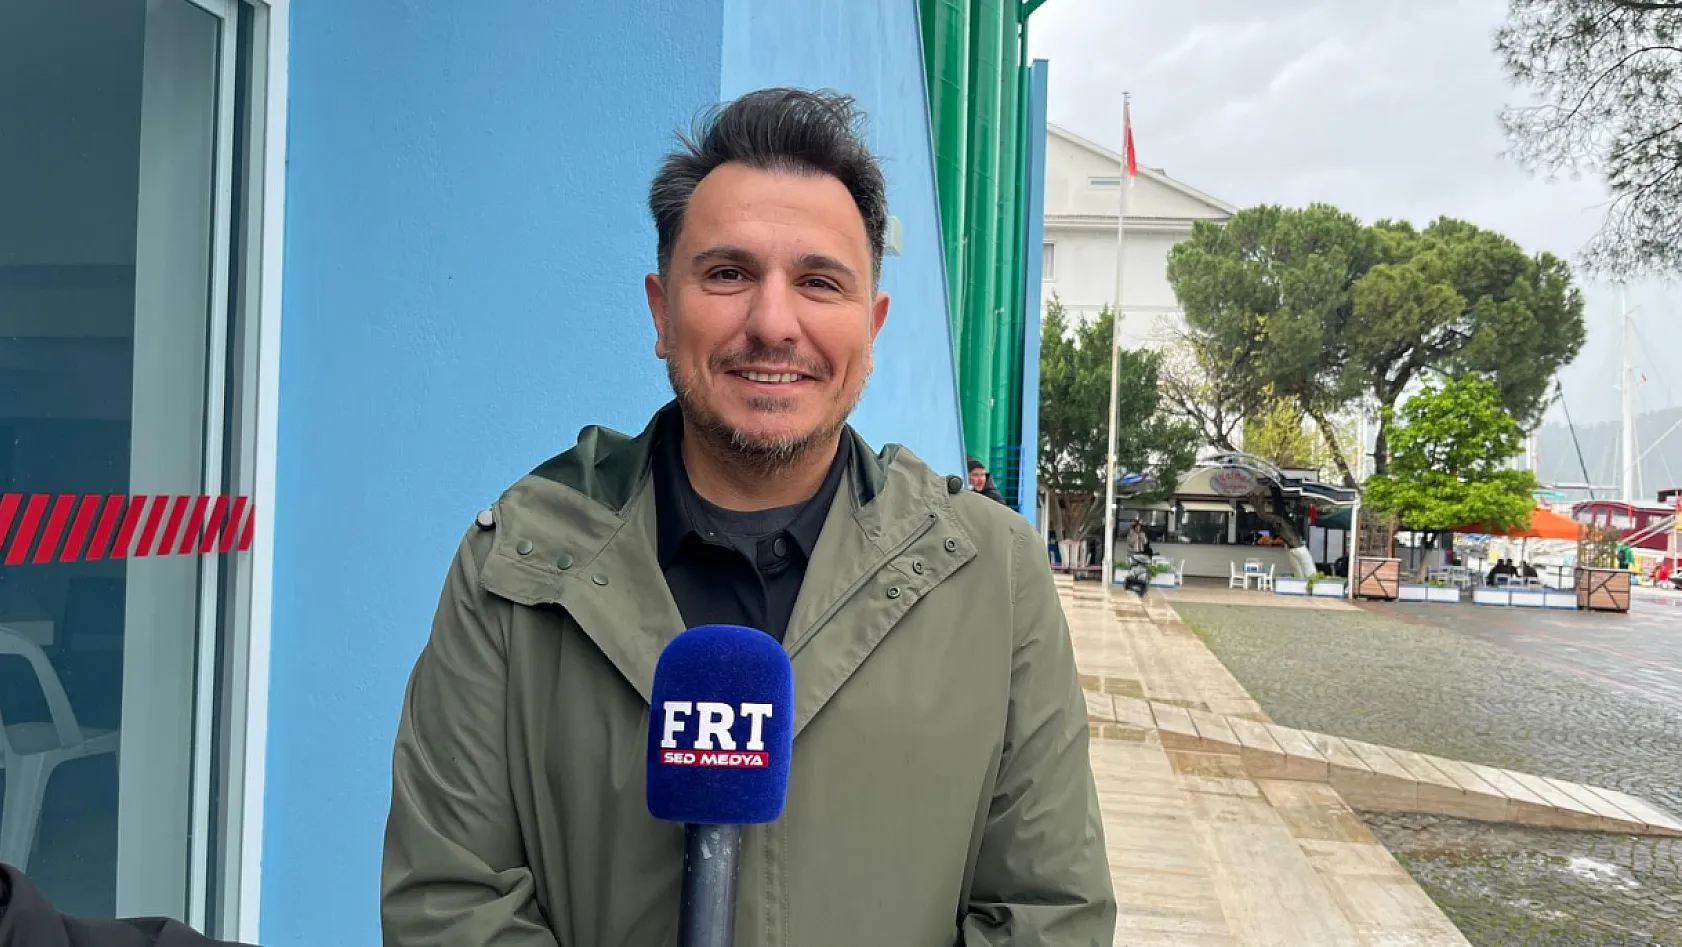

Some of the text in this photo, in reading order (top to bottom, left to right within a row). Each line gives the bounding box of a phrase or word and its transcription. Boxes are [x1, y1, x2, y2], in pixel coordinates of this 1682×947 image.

[661, 701, 773, 751] FRT
[664, 752, 764, 766] SED MEDYA
